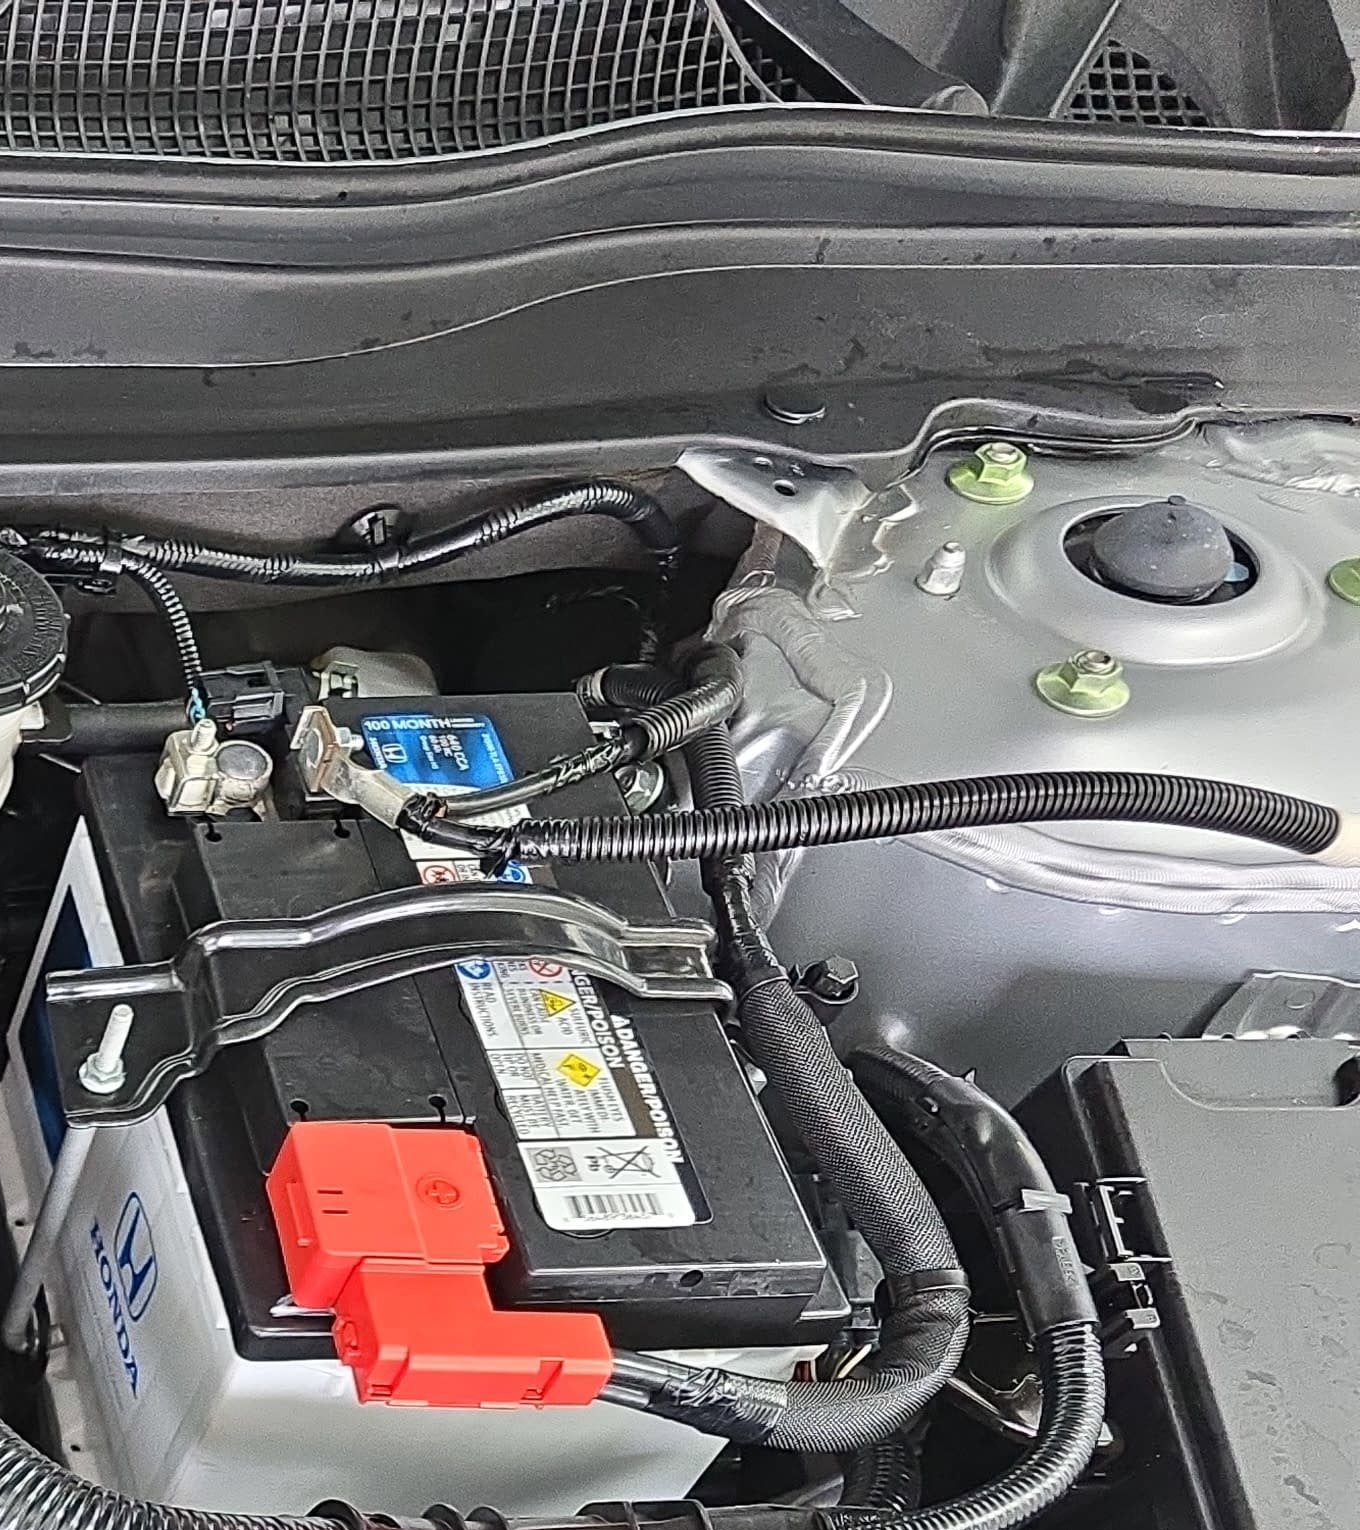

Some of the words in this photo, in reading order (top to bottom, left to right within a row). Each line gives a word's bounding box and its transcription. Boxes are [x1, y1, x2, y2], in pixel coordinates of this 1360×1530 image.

[364, 719, 391, 731] 100
[391, 718, 451, 729] MONTH
[615, 1027, 685, 1164] DANGER/POISON
[584, 1155, 601, 1172] Pb
[90, 1216, 139, 1400] HONDA
